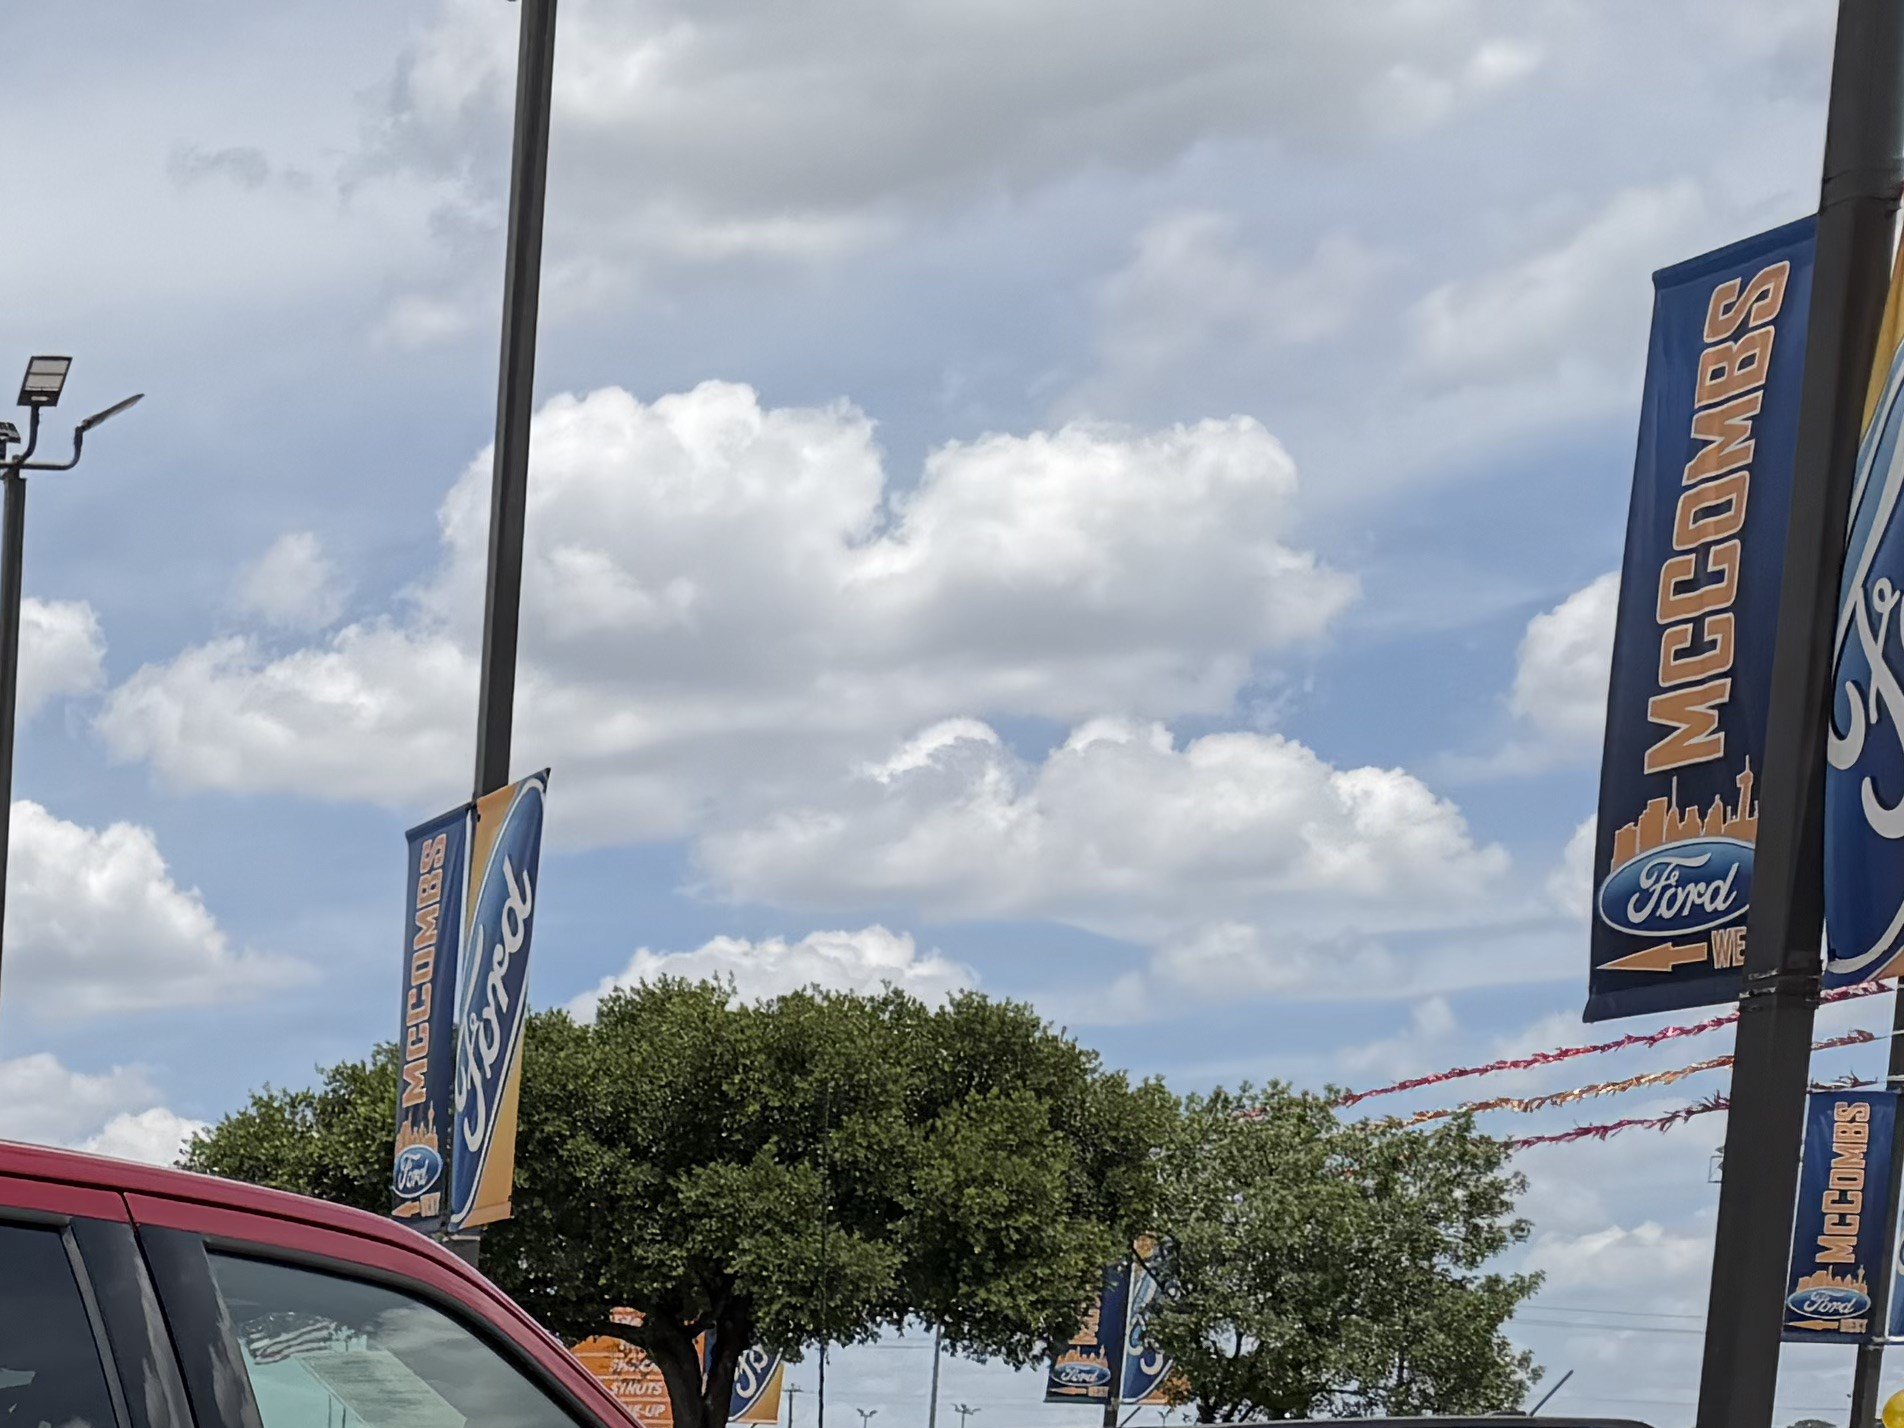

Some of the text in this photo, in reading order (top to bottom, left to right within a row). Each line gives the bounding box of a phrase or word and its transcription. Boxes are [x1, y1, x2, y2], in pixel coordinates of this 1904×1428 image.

[1626, 851, 1741, 924] Ford
[1710, 926, 1748, 970] WE
[454, 854, 534, 1153] Ford
[397, 1152, 429, 1191] Ford
[1803, 1290, 1856, 1315] Ford
